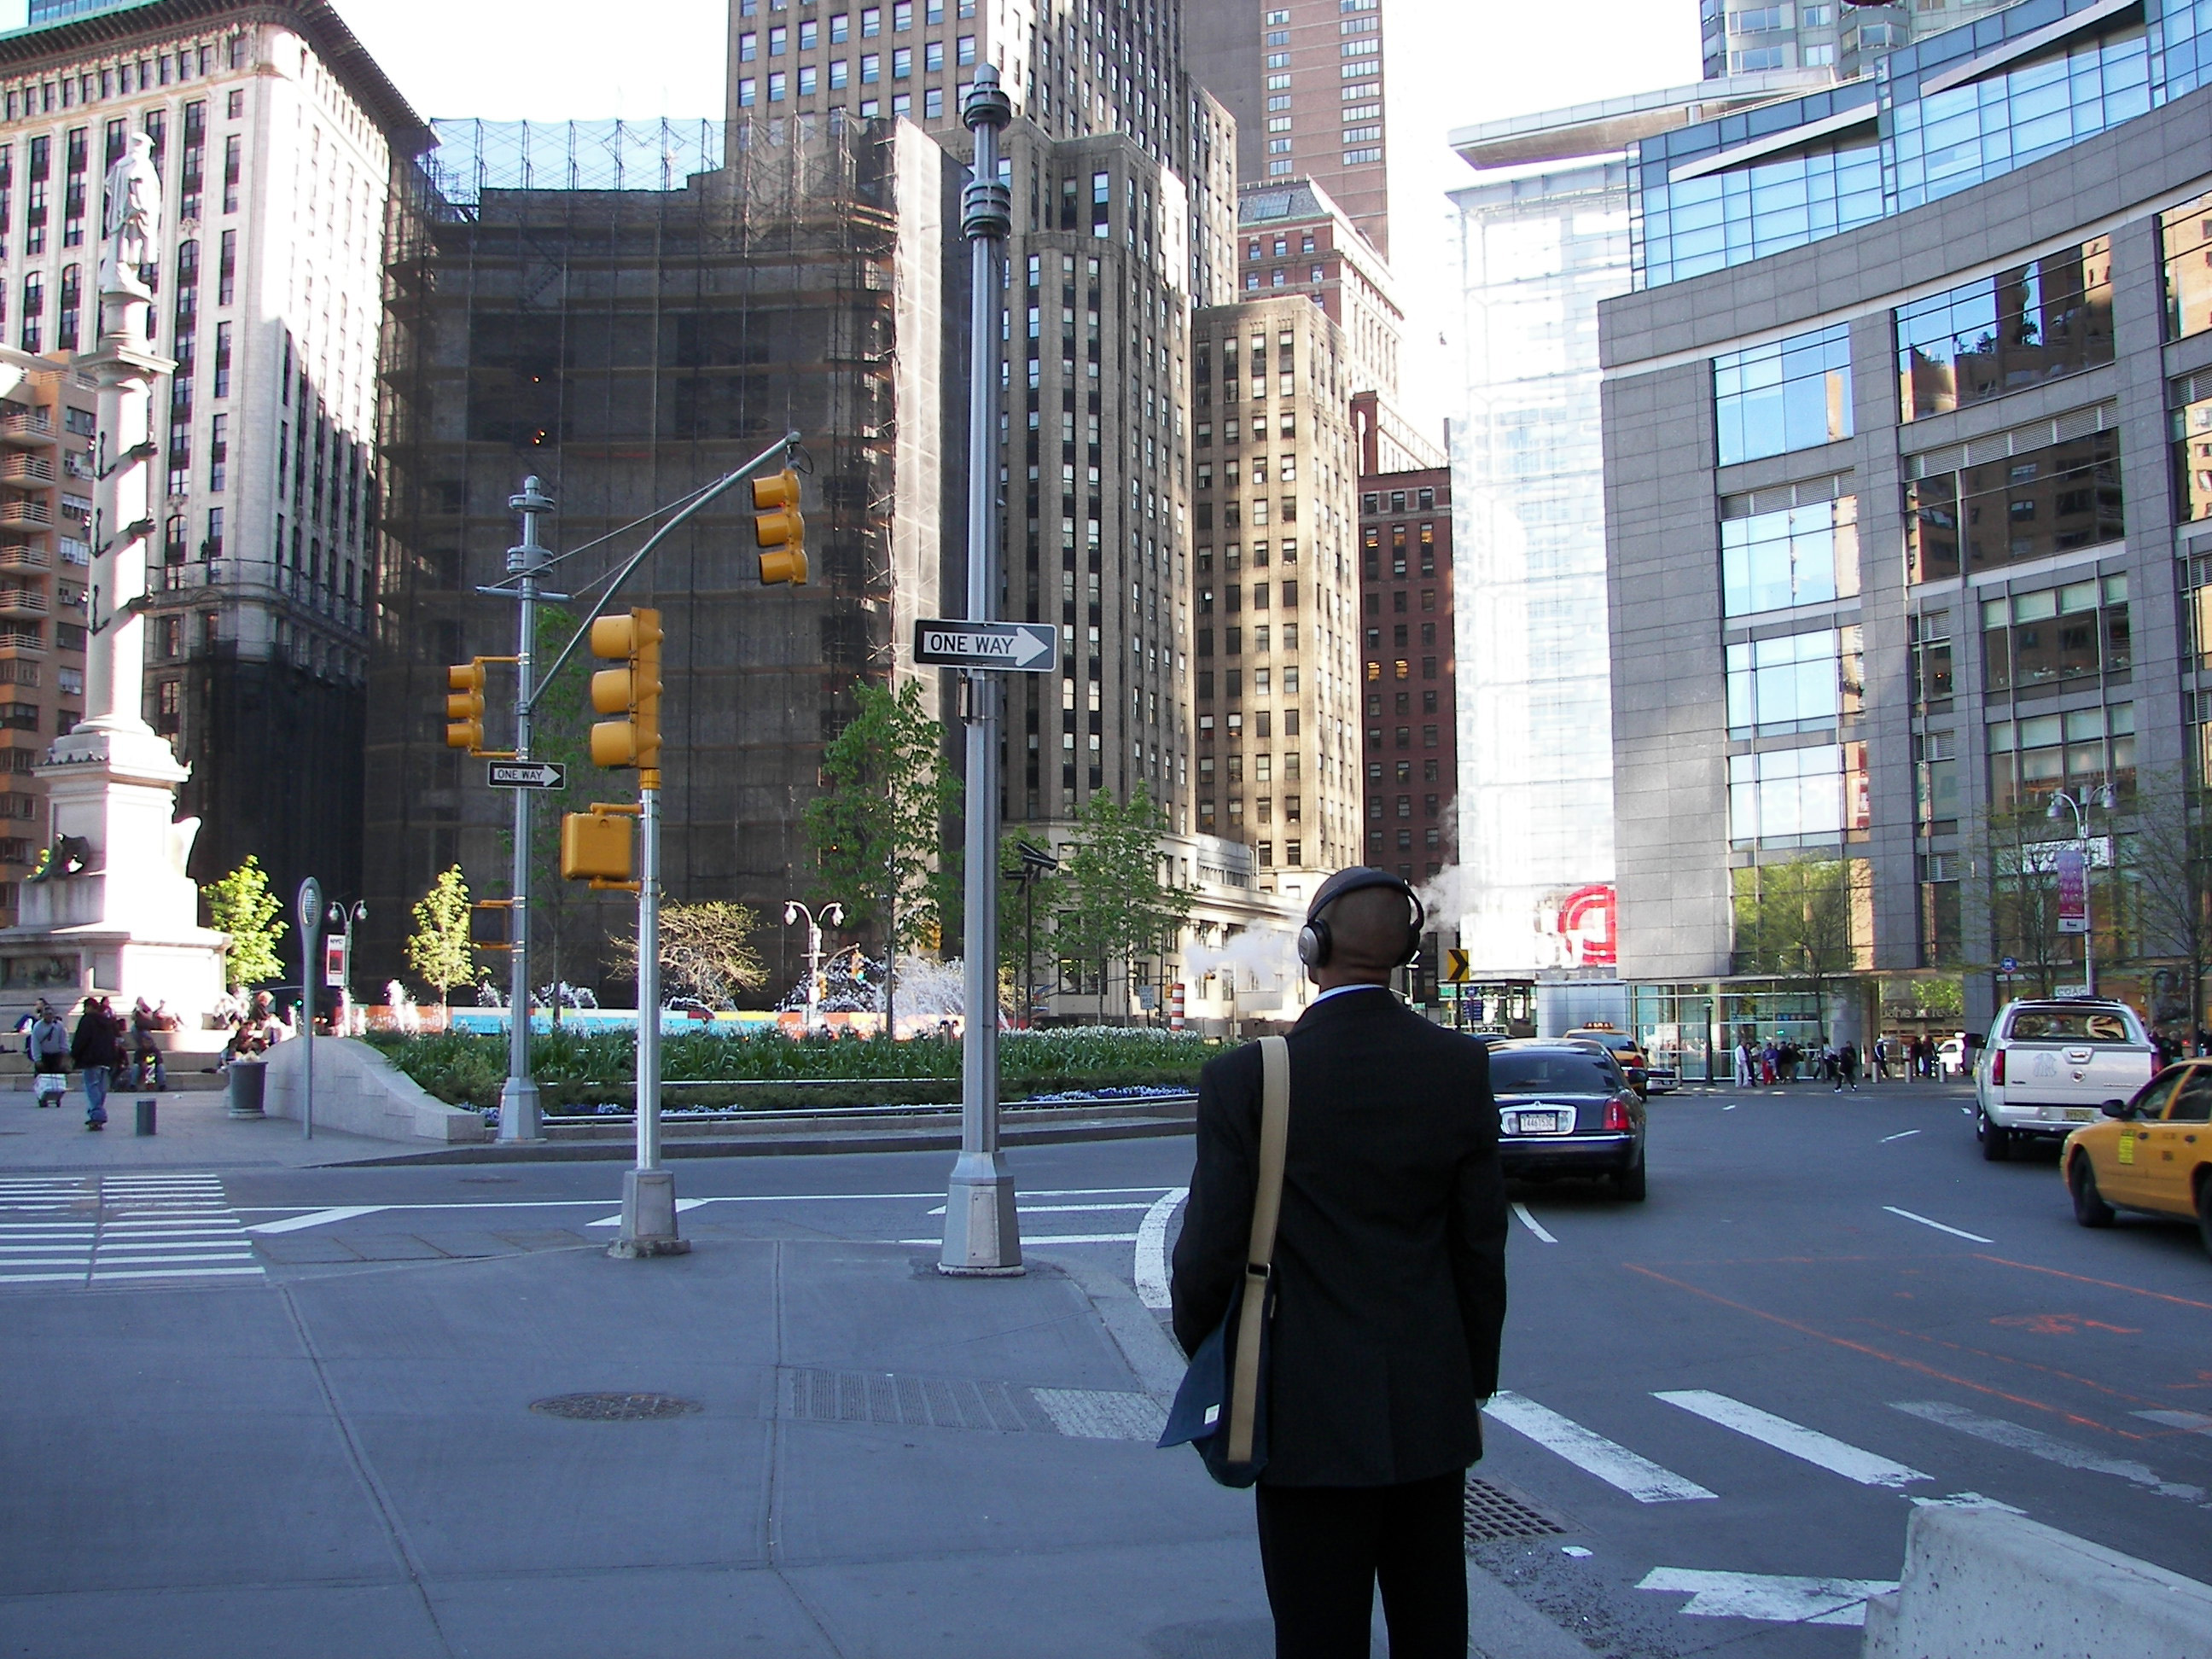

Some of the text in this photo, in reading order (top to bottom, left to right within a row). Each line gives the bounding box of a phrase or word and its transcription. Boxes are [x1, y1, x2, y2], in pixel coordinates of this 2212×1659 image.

[931, 634, 1014, 655] ONE WAY
[498, 769, 543, 780] ONE WAY
[2057, 987, 2087, 996] COAC
